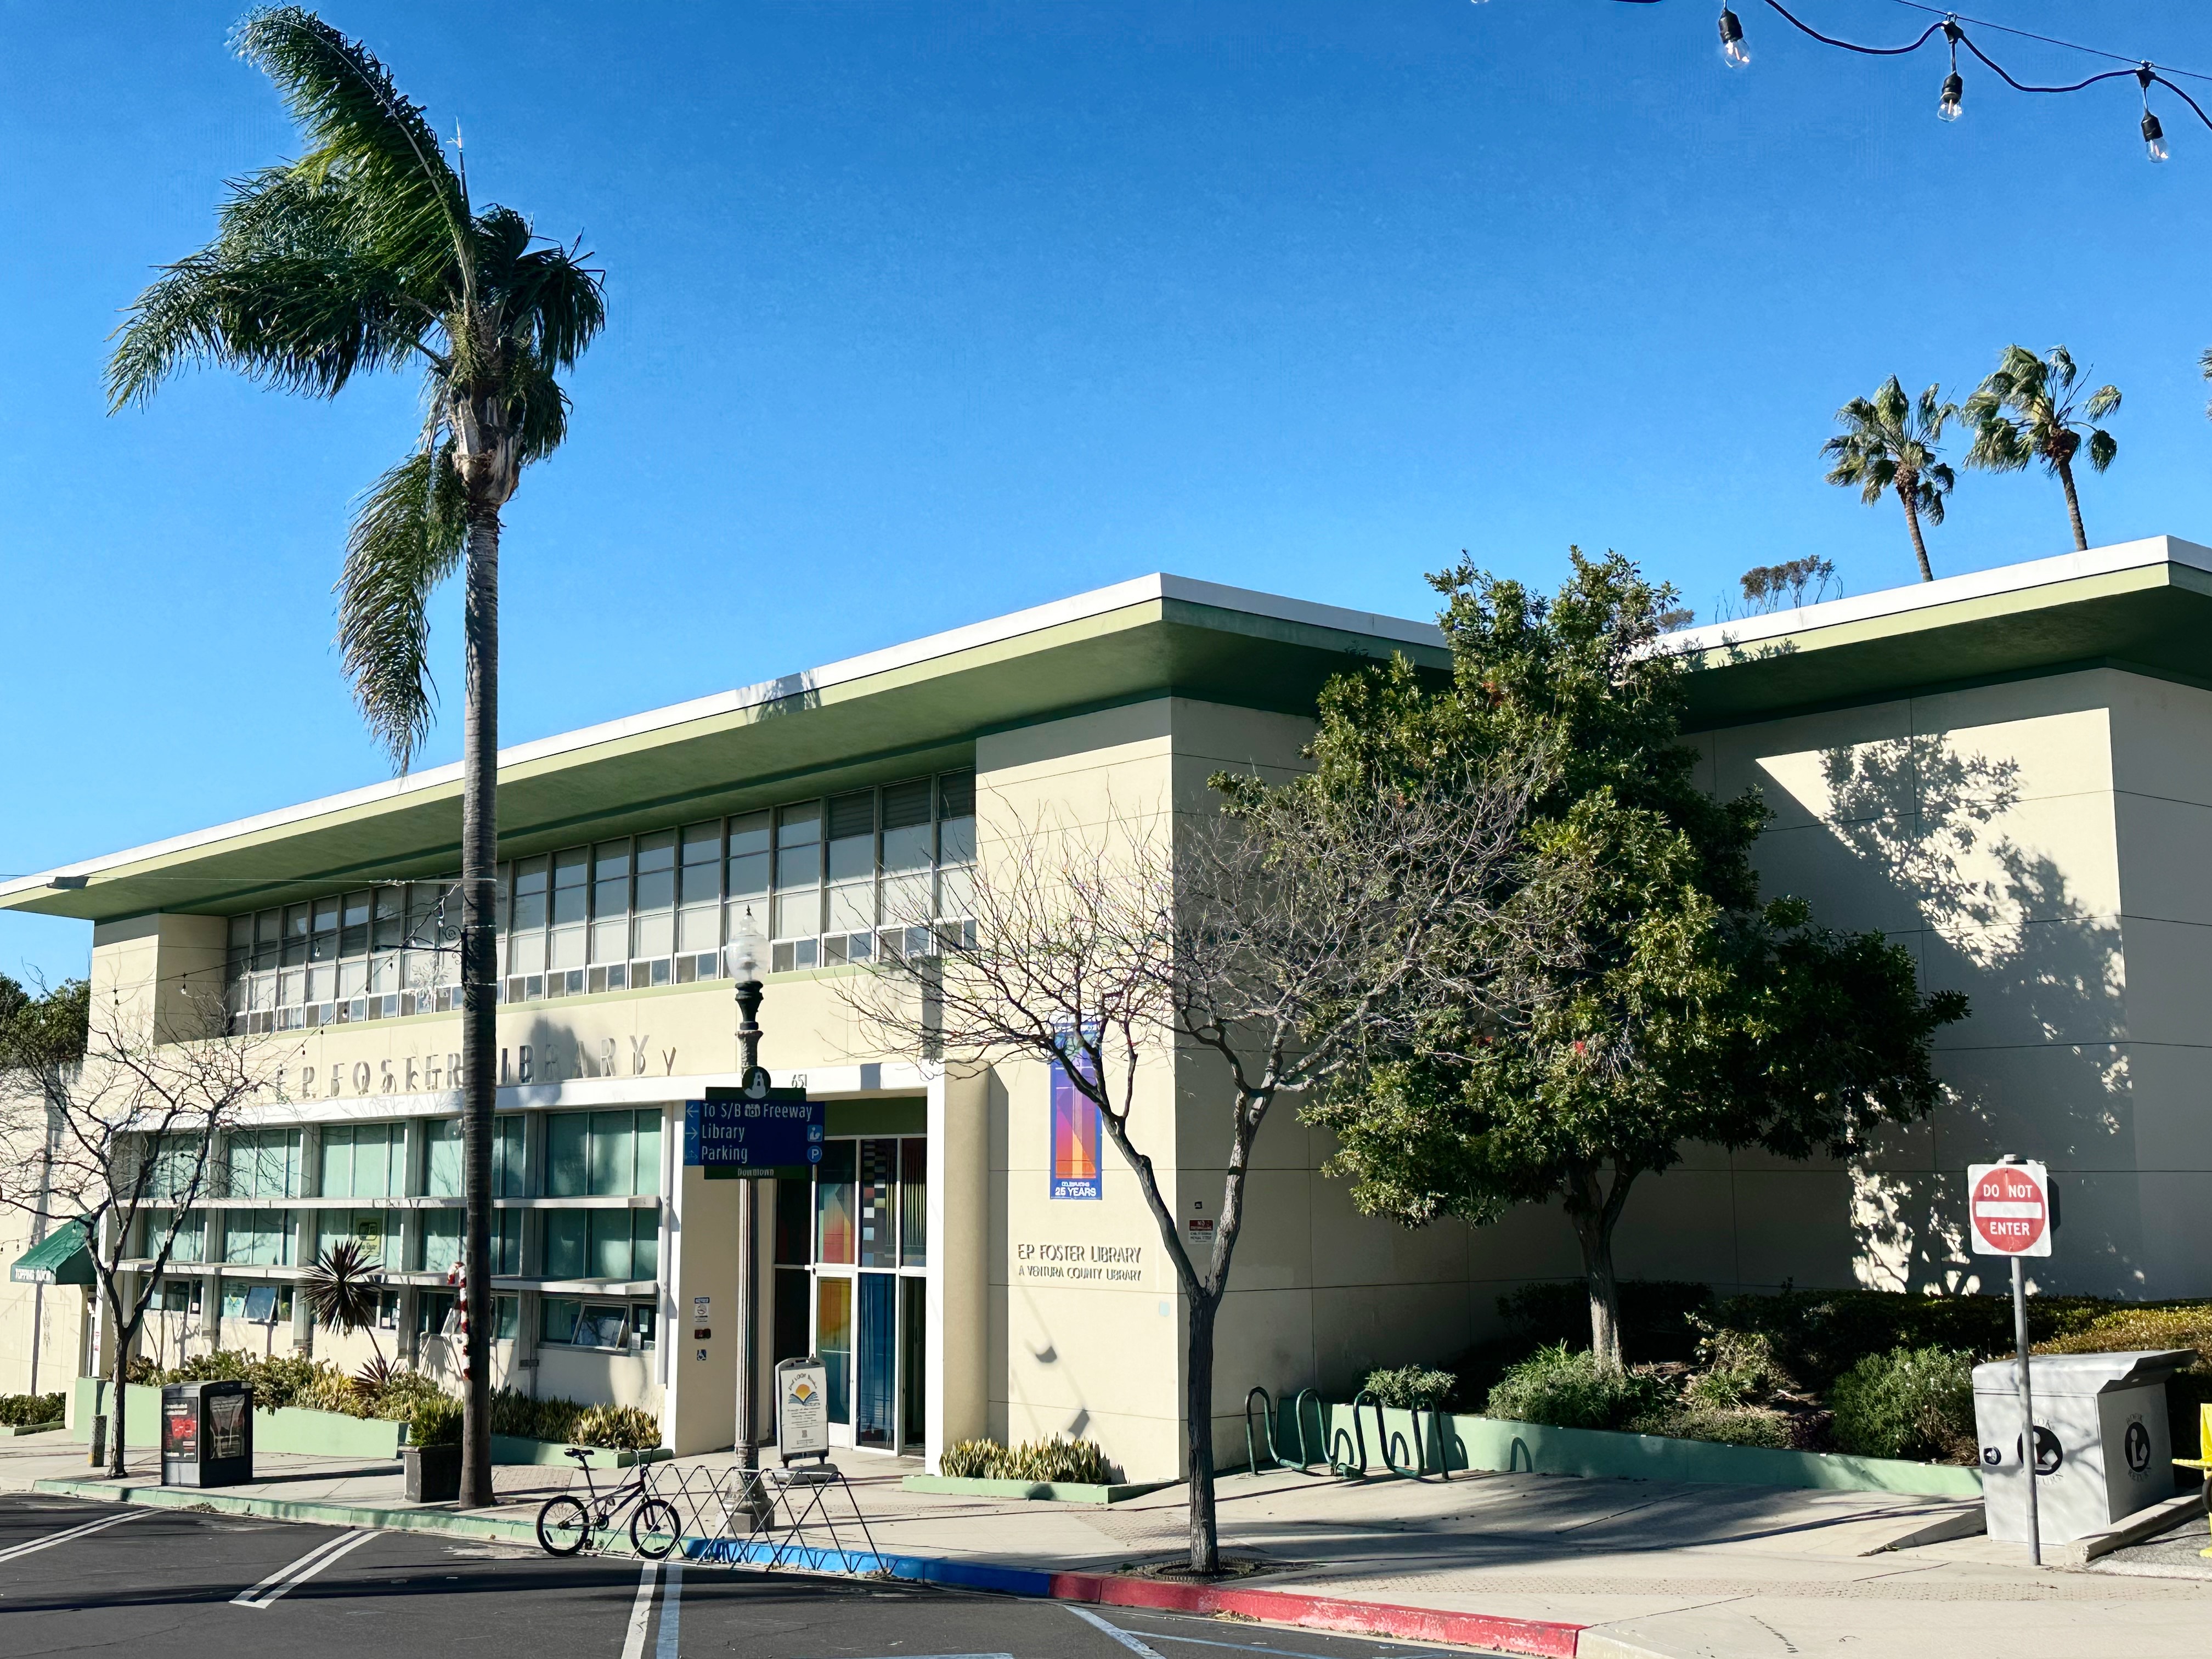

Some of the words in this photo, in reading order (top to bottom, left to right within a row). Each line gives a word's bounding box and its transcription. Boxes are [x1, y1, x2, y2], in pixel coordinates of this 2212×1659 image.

[500, 1035, 650, 1085] IBRARY
[792, 1074, 807, 1088] 651
[703, 1103, 715, 1118] To
[721, 1103, 741, 1119] S/B
[764, 1103, 812, 1121] Freeway
[702, 1123, 745, 1142] Library
[702, 1145, 748, 1164] Parking
[737, 1167, 775, 1177] Downtown
[1055, 1187, 1066, 1196] 25
[1068, 1187, 1097, 1197] YEARS
[1983, 1184, 2000, 1198] DO
[2008, 1184, 2033, 1198] NOT
[1989, 1221, 2030, 1235] ENTER
[1040, 1244, 1086, 1262] FOSTER
[1091, 1246, 1142, 1263] LIBRARY
[1019, 1265, 1025, 1276] A
[1027, 1265, 1064, 1278] VENTURA
[1066, 1267, 1102, 1279] COUNTY
[1107, 1268, 1142, 1281] LIBRARY
[2032, 1417, 2054, 1431] OOK
